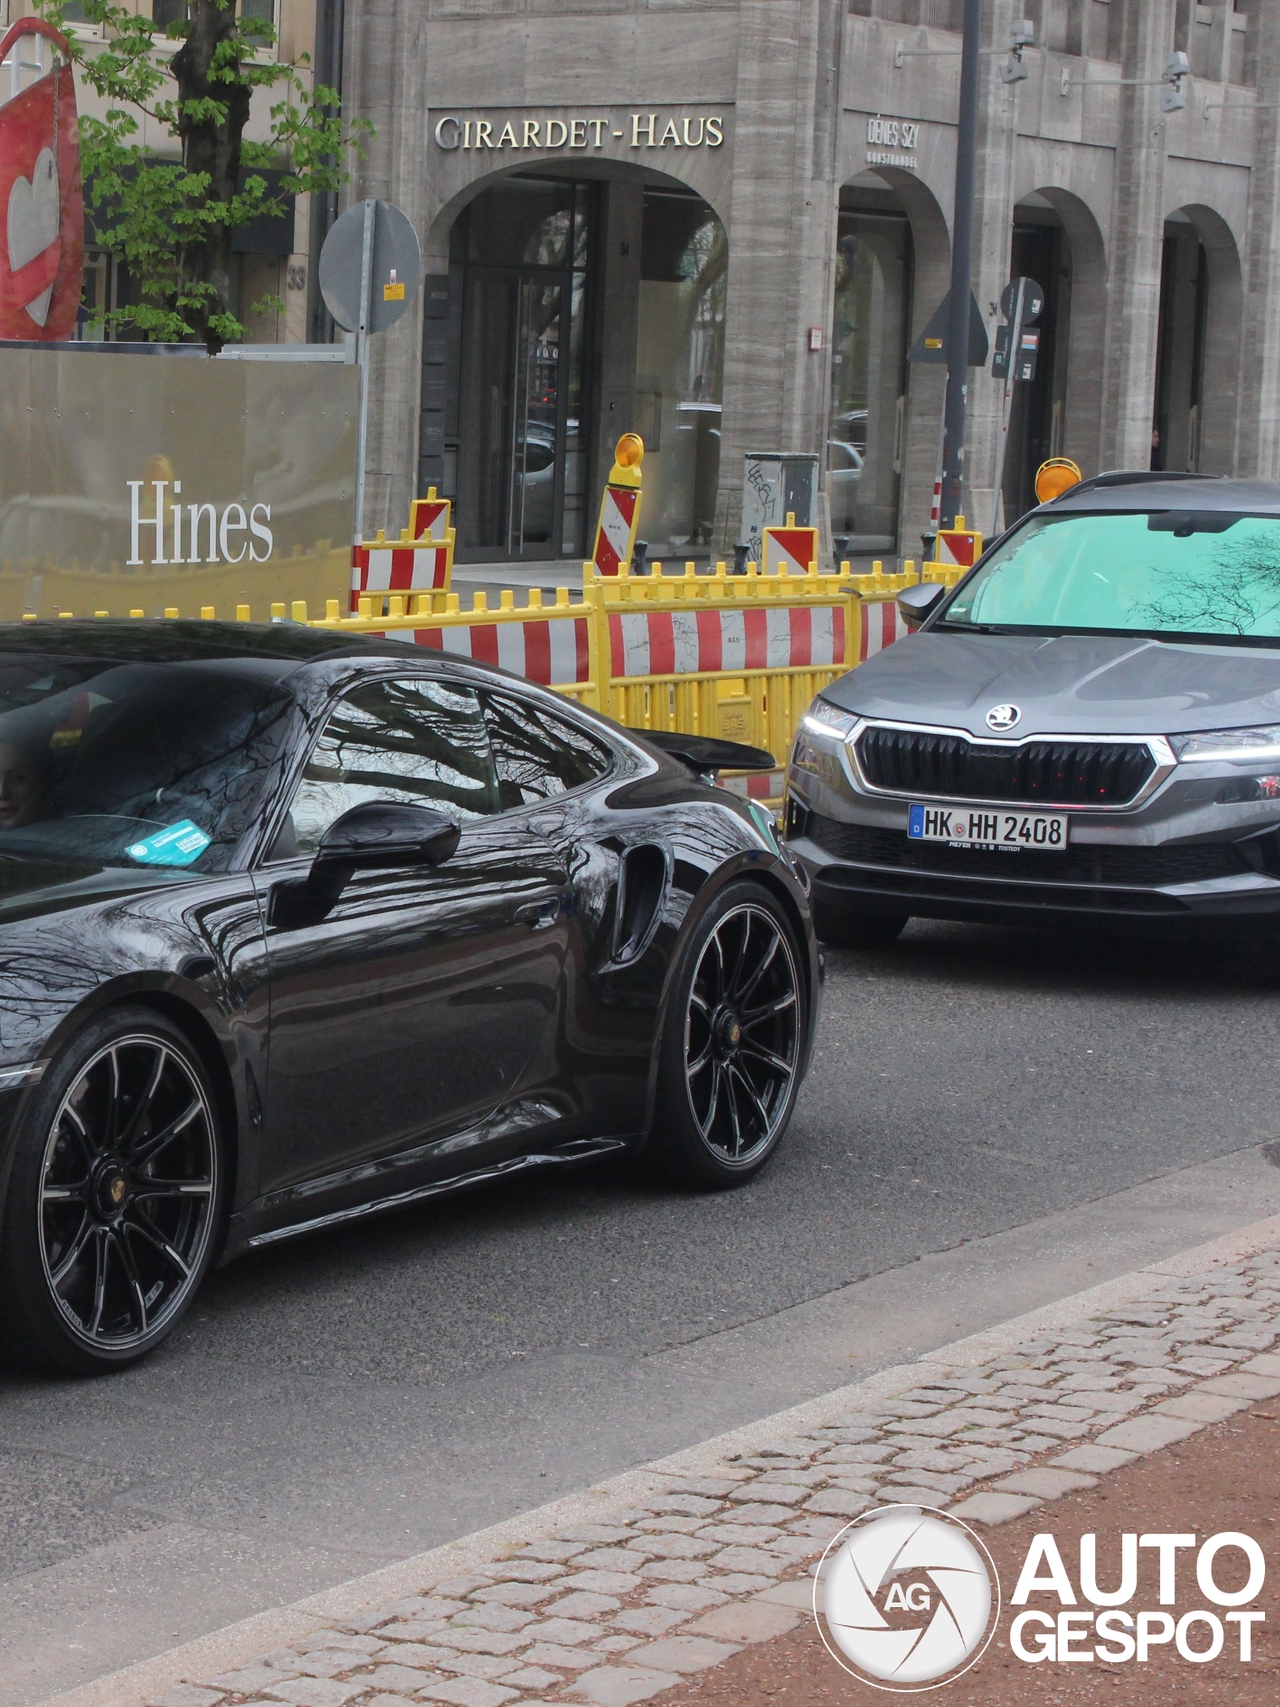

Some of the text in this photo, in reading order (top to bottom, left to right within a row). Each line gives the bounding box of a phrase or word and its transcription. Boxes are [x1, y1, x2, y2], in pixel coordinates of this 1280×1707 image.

[901, 123, 920, 149] SZY
[126, 480, 273, 565] Hines
[913, 825, 920, 833] D
[924, 810, 1062, 845] HK HH 2408
